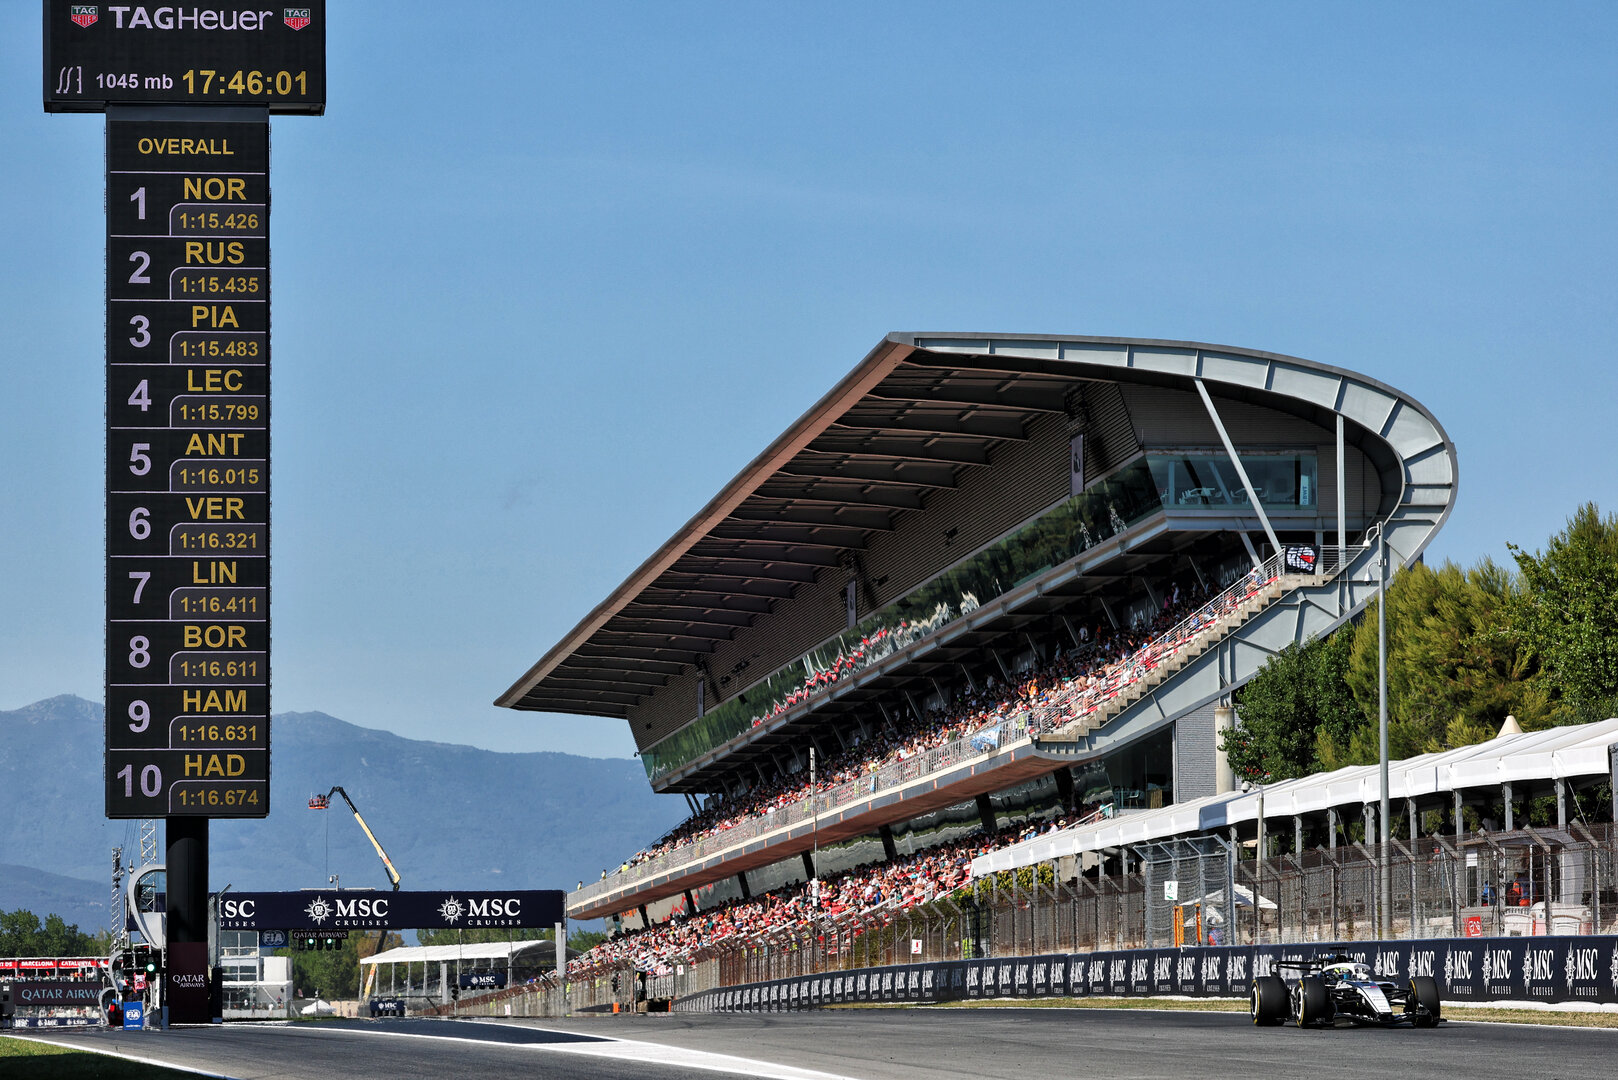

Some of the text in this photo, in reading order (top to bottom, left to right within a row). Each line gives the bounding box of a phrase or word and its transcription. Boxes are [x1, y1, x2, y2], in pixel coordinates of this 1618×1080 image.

[71, 14, 98, 23] HEUER
[72, 6, 97, 16] TAG
[284, 9, 310, 19] TAG
[284, 18, 310, 28] HEUER
[96, 73, 174, 90] 1045 mb
[182, 70, 308, 96] 17:46:01
[138, 137, 235, 155] OVERALL
[183, 177, 247, 201] NOR
[130, 187, 146, 220] 1
[179, 213, 259, 229] 1:15.426
[185, 241, 245, 265] RUS
[128, 251, 151, 284] 2
[179, 276, 259, 293] 1:15.435
[192, 305, 240, 328] PIA
[129, 314, 151, 348] 3
[179, 340, 258, 357] 1:15.483
[187, 369, 243, 392] LEC
[127, 379, 152, 412] 4
[180, 404, 259, 421] 1:15.799
[185, 433, 245, 456] ANT
[129, 443, 152, 476] 5
[179, 468, 259, 485] 1:16.015
[185, 497, 245, 520] VER
[128, 506, 152, 541] 6
[179, 532, 257, 549] 1:16.321
[193, 561, 237, 584] LIN
[128, 571, 151, 604] 7
[180, 596, 257, 613] 1:16.411
[183, 625, 248, 648] BOR
[128, 635, 151, 669] 8
[180, 660, 257, 677] 1:16.611
[183, 689, 247, 713] HAM
[128, 699, 151, 733] 9
[179, 725, 257, 741] 1:16.631
[184, 753, 246, 777] HAD
[117, 764, 162, 798] 10
[179, 789, 259, 806] 1:16.674
[219, 899, 255, 918] SC
[335, 898, 389, 918] MSC
[467, 898, 521, 917] MSC
[467, 918, 521, 926] CRUISES
[262, 932, 284, 944] FIA
[293, 932, 317, 940] QATAR
[1232, 955, 1248, 980] MSC
[1382, 950, 1400, 977] MSC
[1417, 950, 1435, 977] MSC
[1453, 950, 1473, 980] MSC
[1491, 949, 1513, 980] MSC
[1532, 949, 1554, 980] MSC
[1575, 948, 1599, 980] MSC
[172, 974, 205, 984] QATAR
[478, 975, 496, 983] MSC
[21, 988, 63, 1001] QATAR
[1453, 985, 1473, 995] CRUISES
[1491, 985, 1512, 995] CRUISES
[1532, 986, 1554, 996] CRUISES
[1575, 986, 1598, 996] CRUISES
